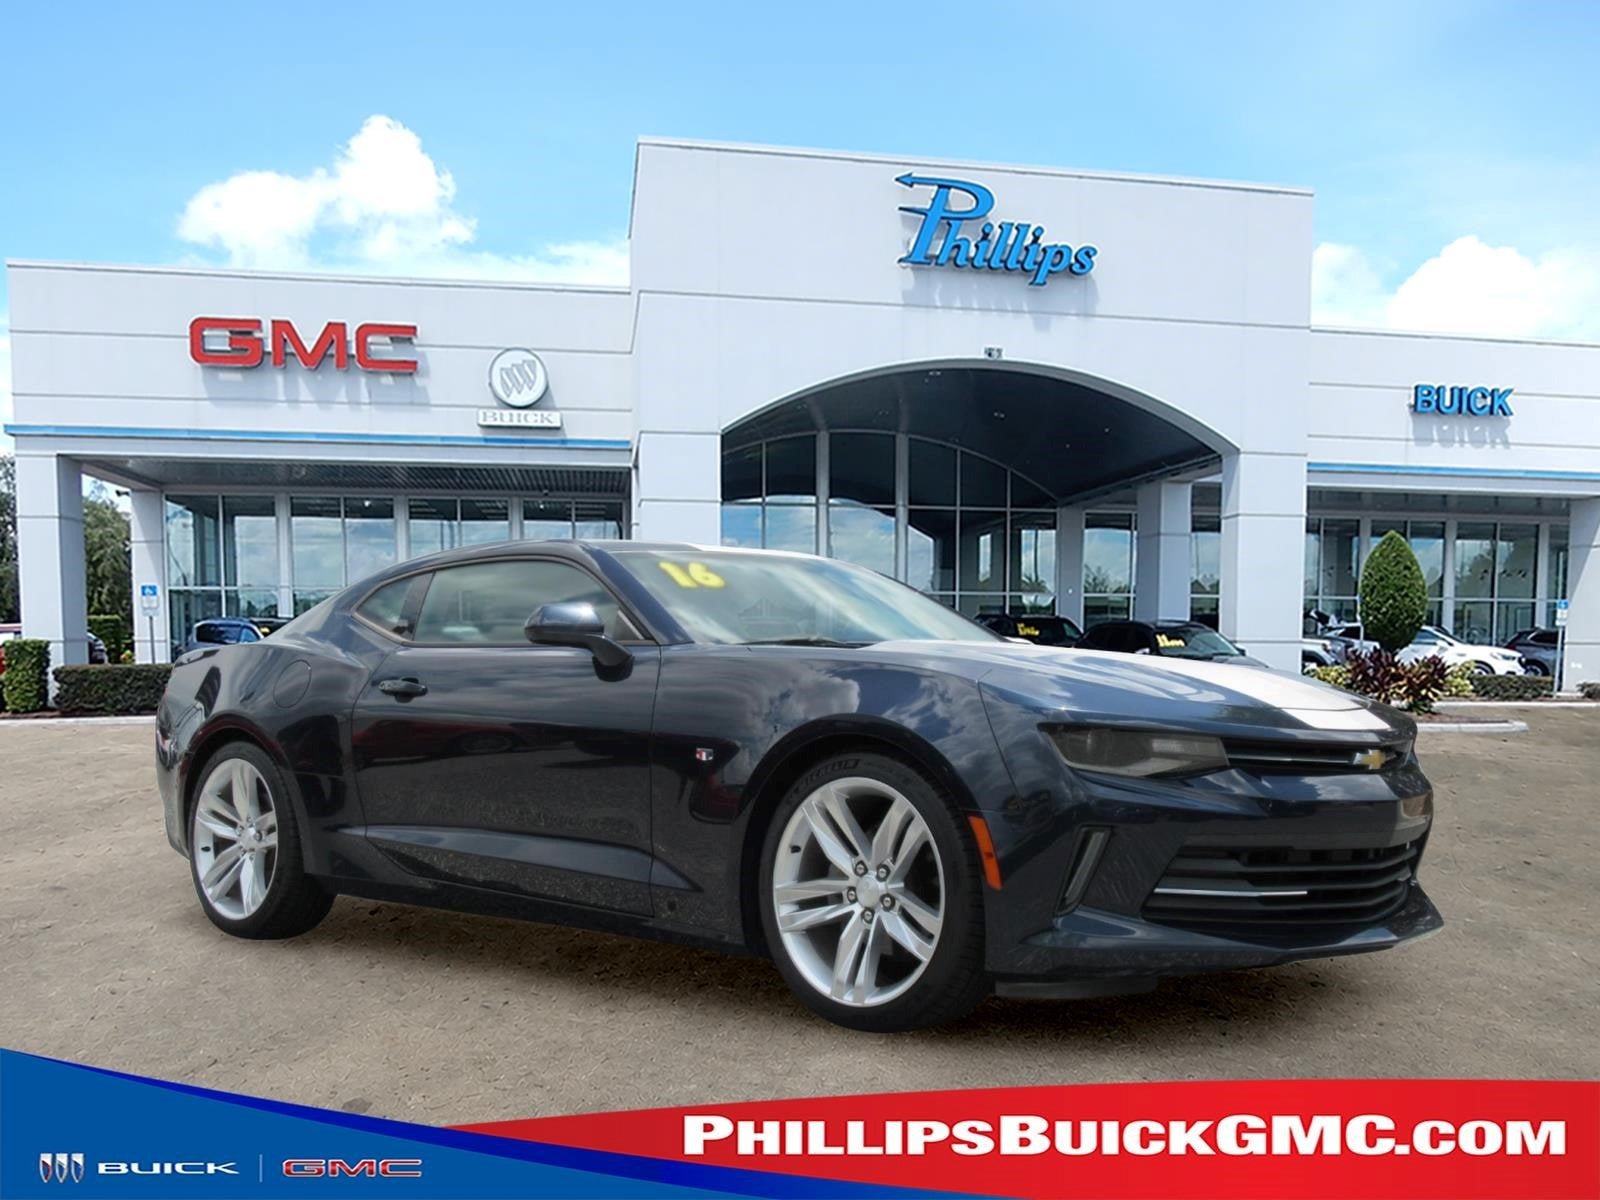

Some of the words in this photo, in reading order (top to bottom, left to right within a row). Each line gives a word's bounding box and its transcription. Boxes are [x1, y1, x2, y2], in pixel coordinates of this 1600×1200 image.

[895, 172, 1098, 286] Phillips
[189, 316, 418, 375] GMC
[1414, 383, 1514, 416] BUICK
[482, 410, 554, 425] BUICK
[658, 560, 726, 588] 16
